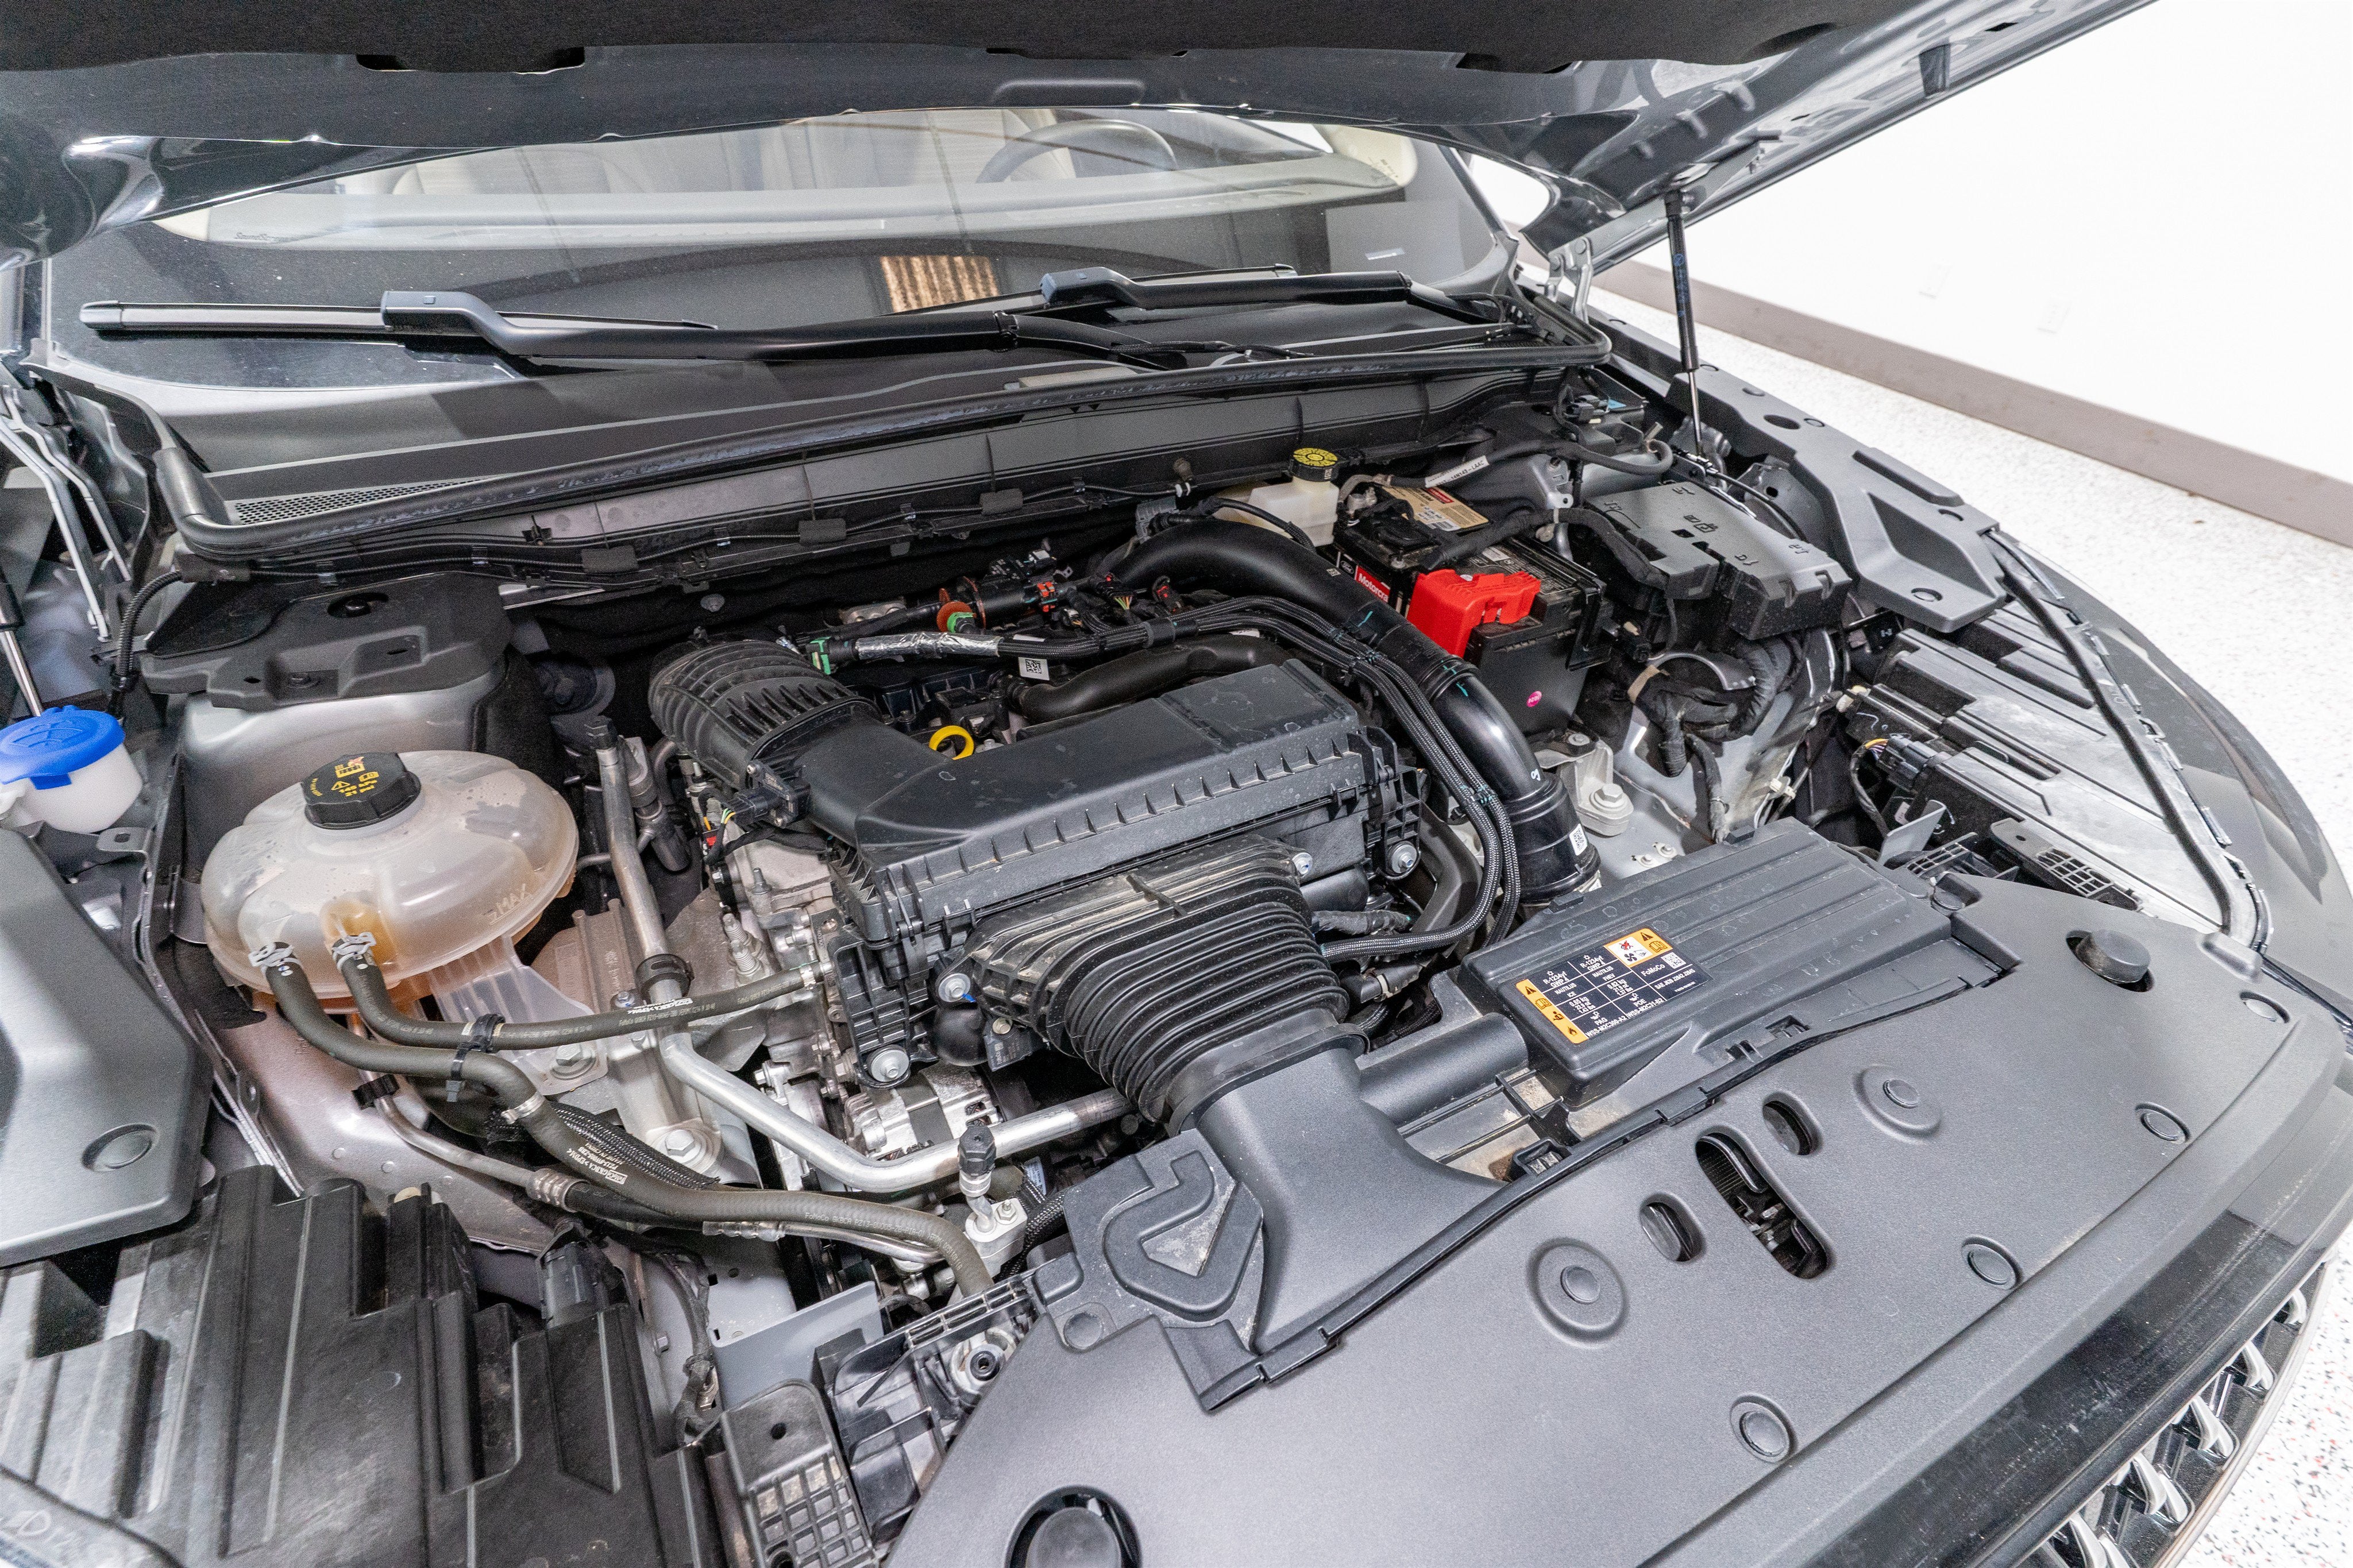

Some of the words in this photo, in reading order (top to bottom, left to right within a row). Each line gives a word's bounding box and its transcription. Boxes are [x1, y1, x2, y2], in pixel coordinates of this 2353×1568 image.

[1358, 573, 1388, 603] Motorcra
[1580, 956, 1603, 968] R-1234yf
[1587, 963, 1600, 971] GWP
[1592, 966, 1614, 978] NAUTILUS
[1641, 964, 1665, 976] FoMoCo
[1543, 971, 1568, 984] R-1234yf
[1550, 979, 1564, 987] GWP
[1554, 983, 1576, 995] NAUTILUS
[1569, 999, 1581, 1007] 0.65
[1633, 999, 1647, 1007] POE
[1594, 1017, 1607, 1026] PAG
